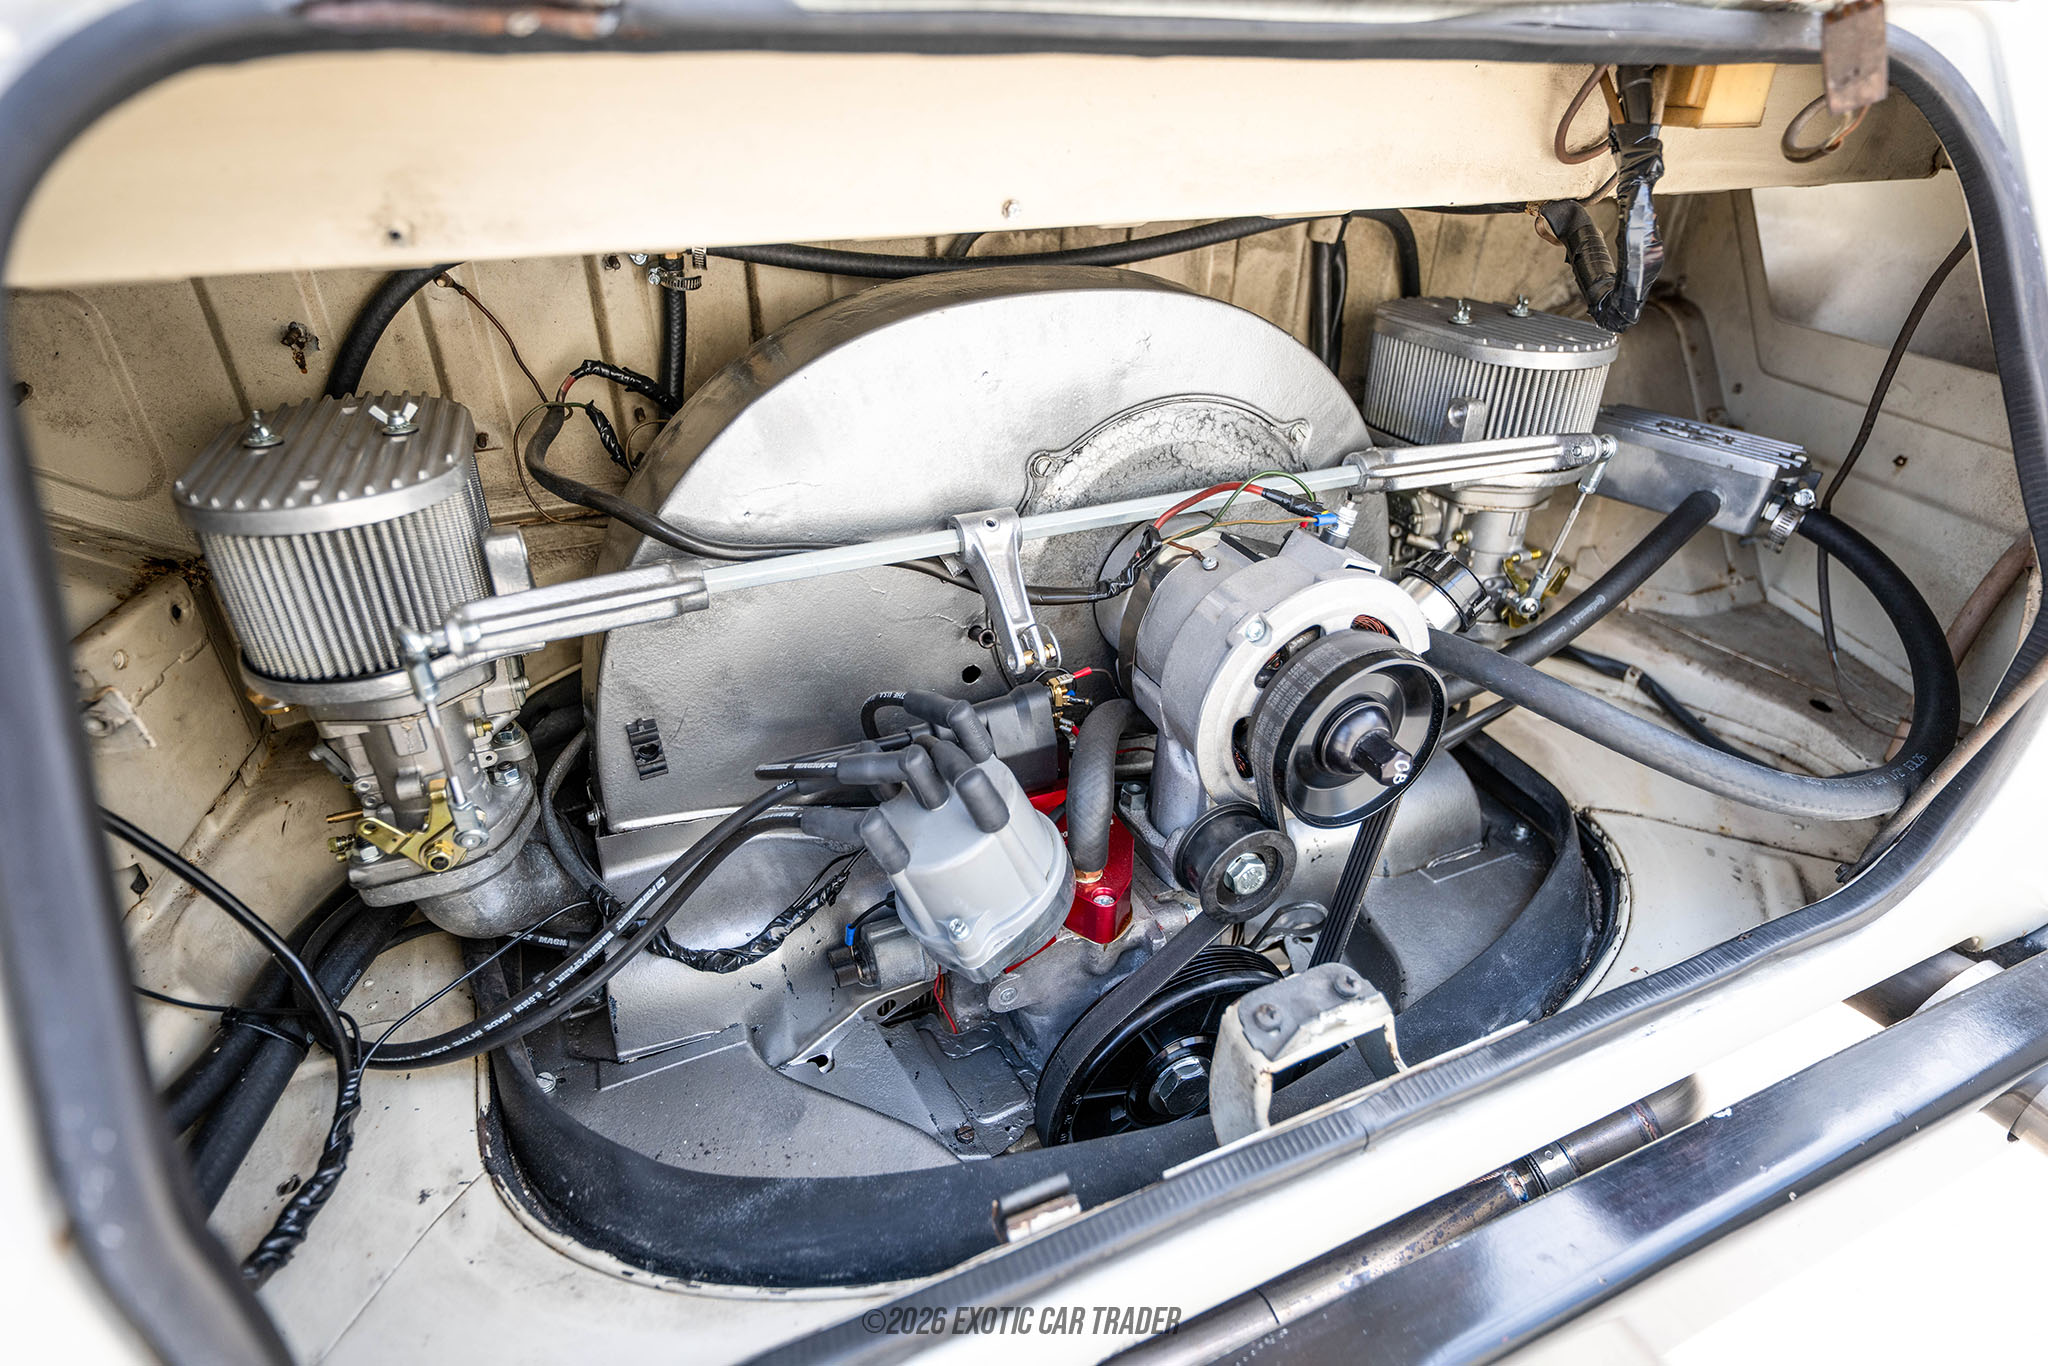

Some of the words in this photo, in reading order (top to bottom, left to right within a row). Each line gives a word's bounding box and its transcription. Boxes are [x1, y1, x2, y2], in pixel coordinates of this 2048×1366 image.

[1393, 760, 1410, 785] CB
[341, 969, 363, 996] ContiTech
[483, 1011, 512, 1031] MADE
